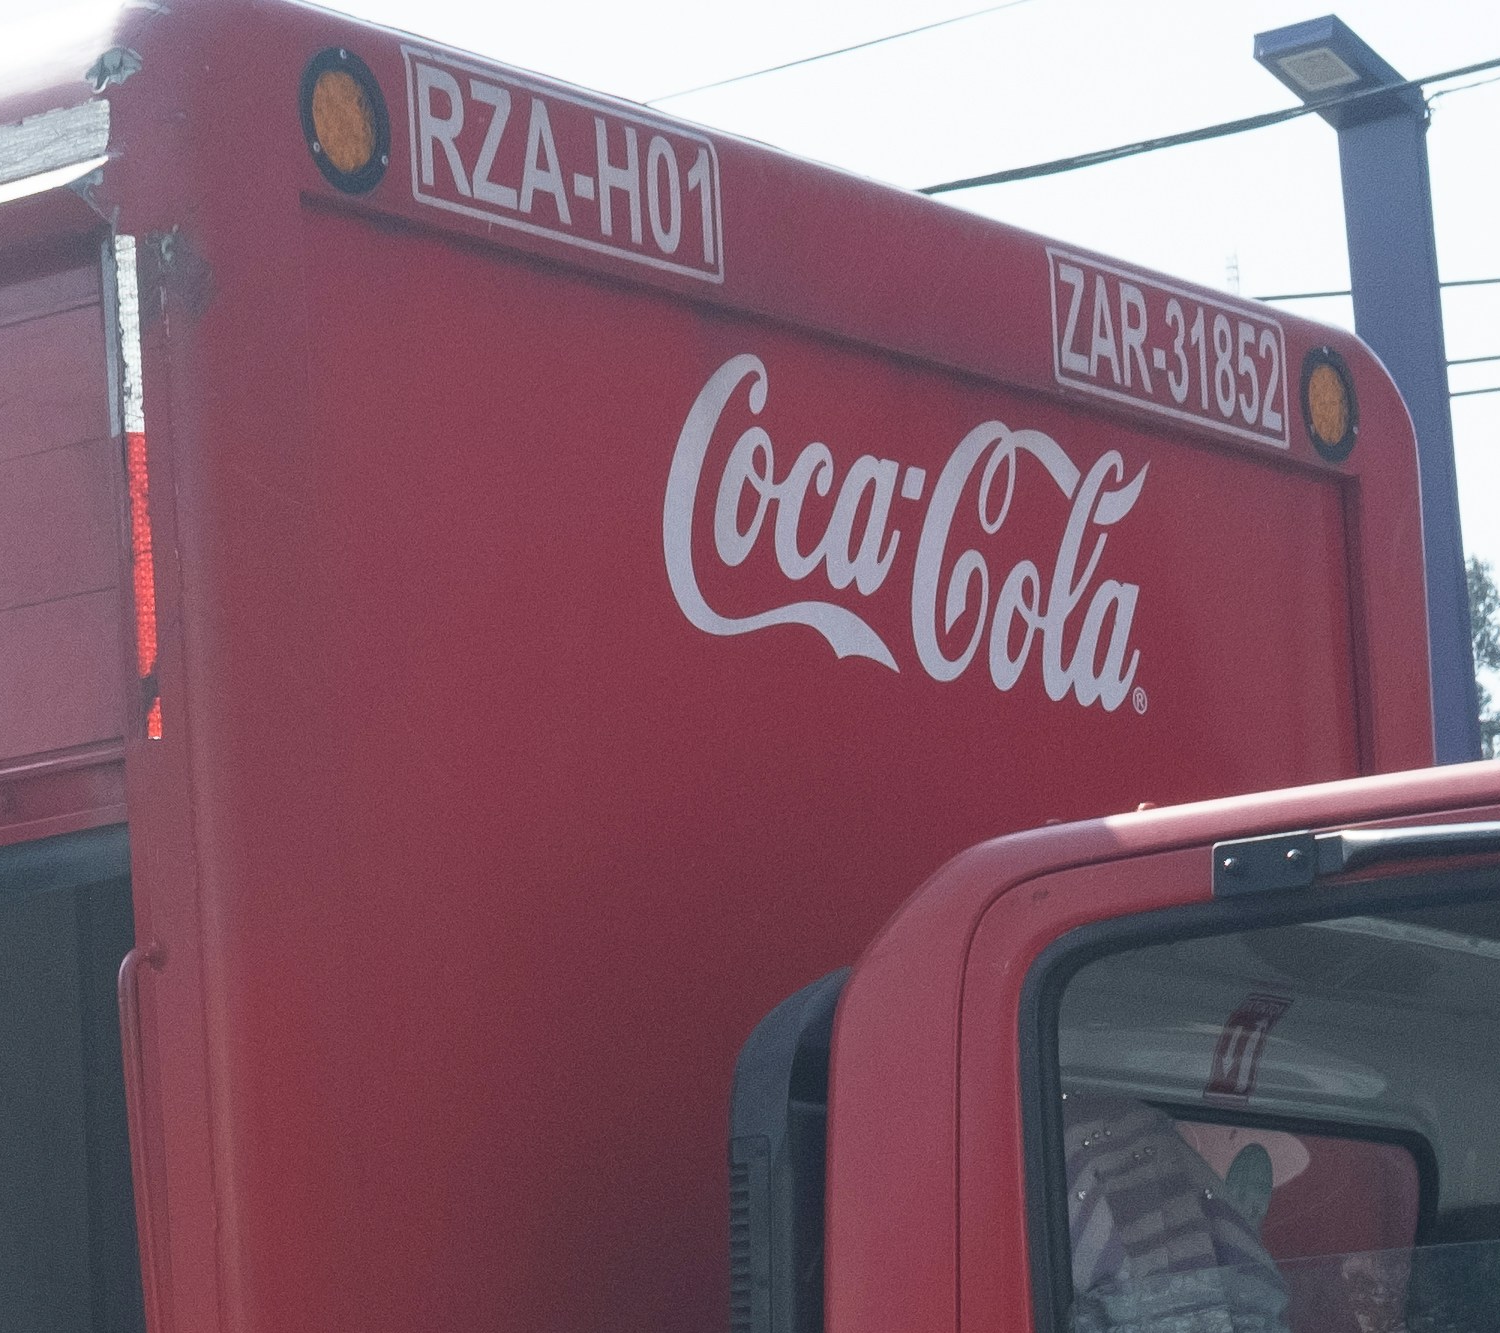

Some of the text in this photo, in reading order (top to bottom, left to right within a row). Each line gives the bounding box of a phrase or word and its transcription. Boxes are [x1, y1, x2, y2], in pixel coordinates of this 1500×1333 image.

[415, 62, 715, 266] RZA-H01
[1058, 263, 1283, 432] ZAR-31852
[662, 352, 1151, 714] Coca-Cola
